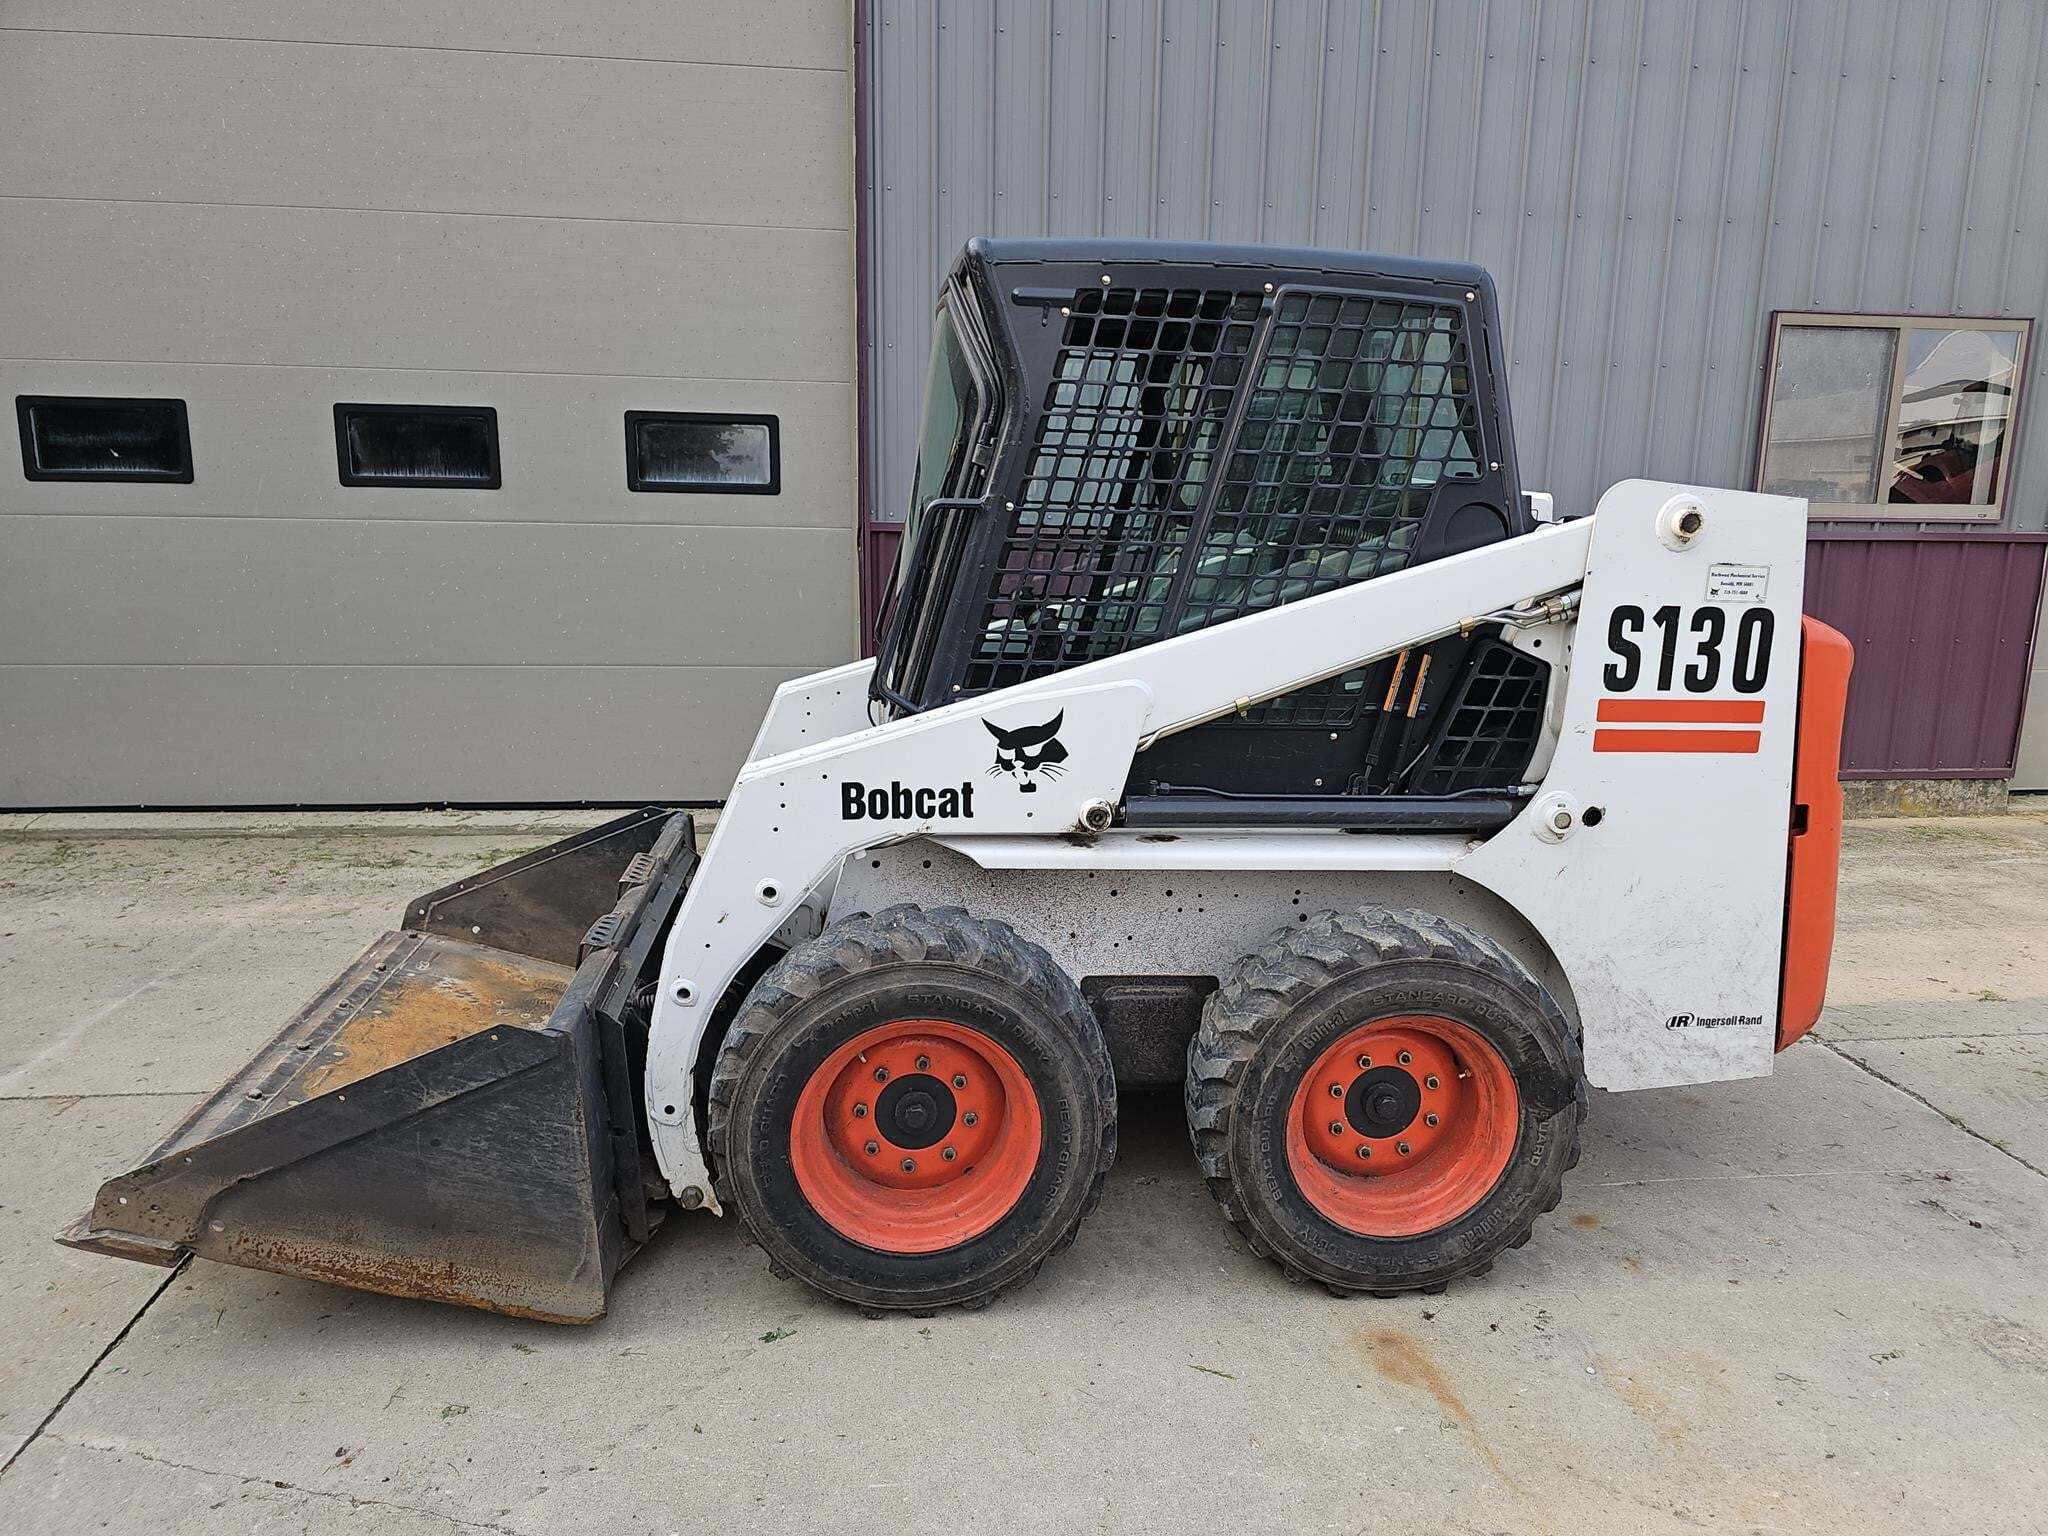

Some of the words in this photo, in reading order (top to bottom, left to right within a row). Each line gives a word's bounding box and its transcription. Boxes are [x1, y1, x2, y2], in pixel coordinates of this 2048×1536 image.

[1603, 605, 1775, 694] S130
[841, 781, 974, 820] Bobcat
[1300, 1008, 1348, 1050] Bobcat
[1262, 1157, 1284, 1201] BEAD
